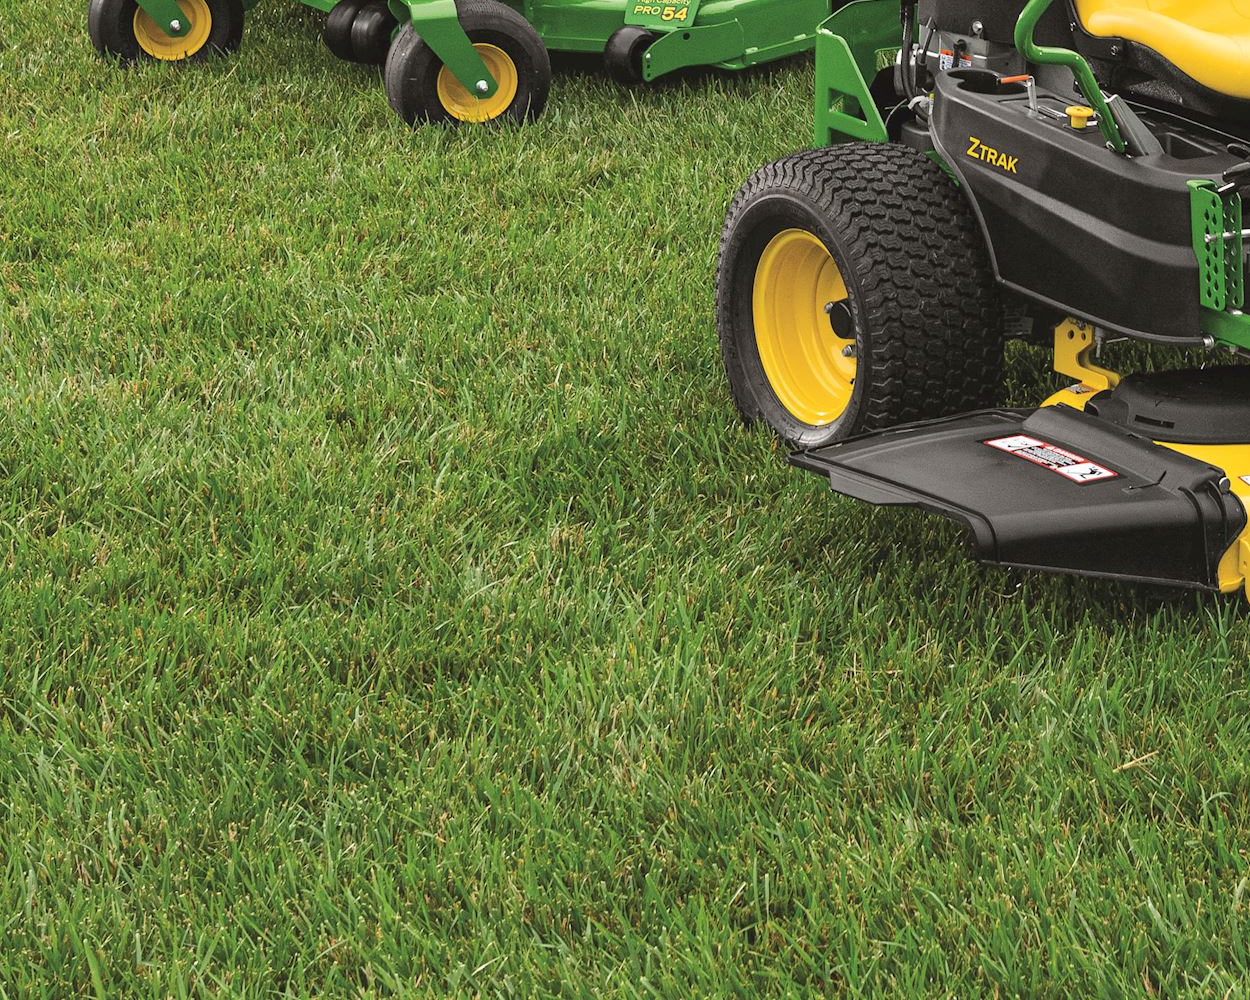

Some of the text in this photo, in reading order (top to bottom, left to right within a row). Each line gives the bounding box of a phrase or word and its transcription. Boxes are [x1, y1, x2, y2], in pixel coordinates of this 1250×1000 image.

[634, 5, 689, 21] PRO 54
[966, 136, 1019, 174] ZTRAK
